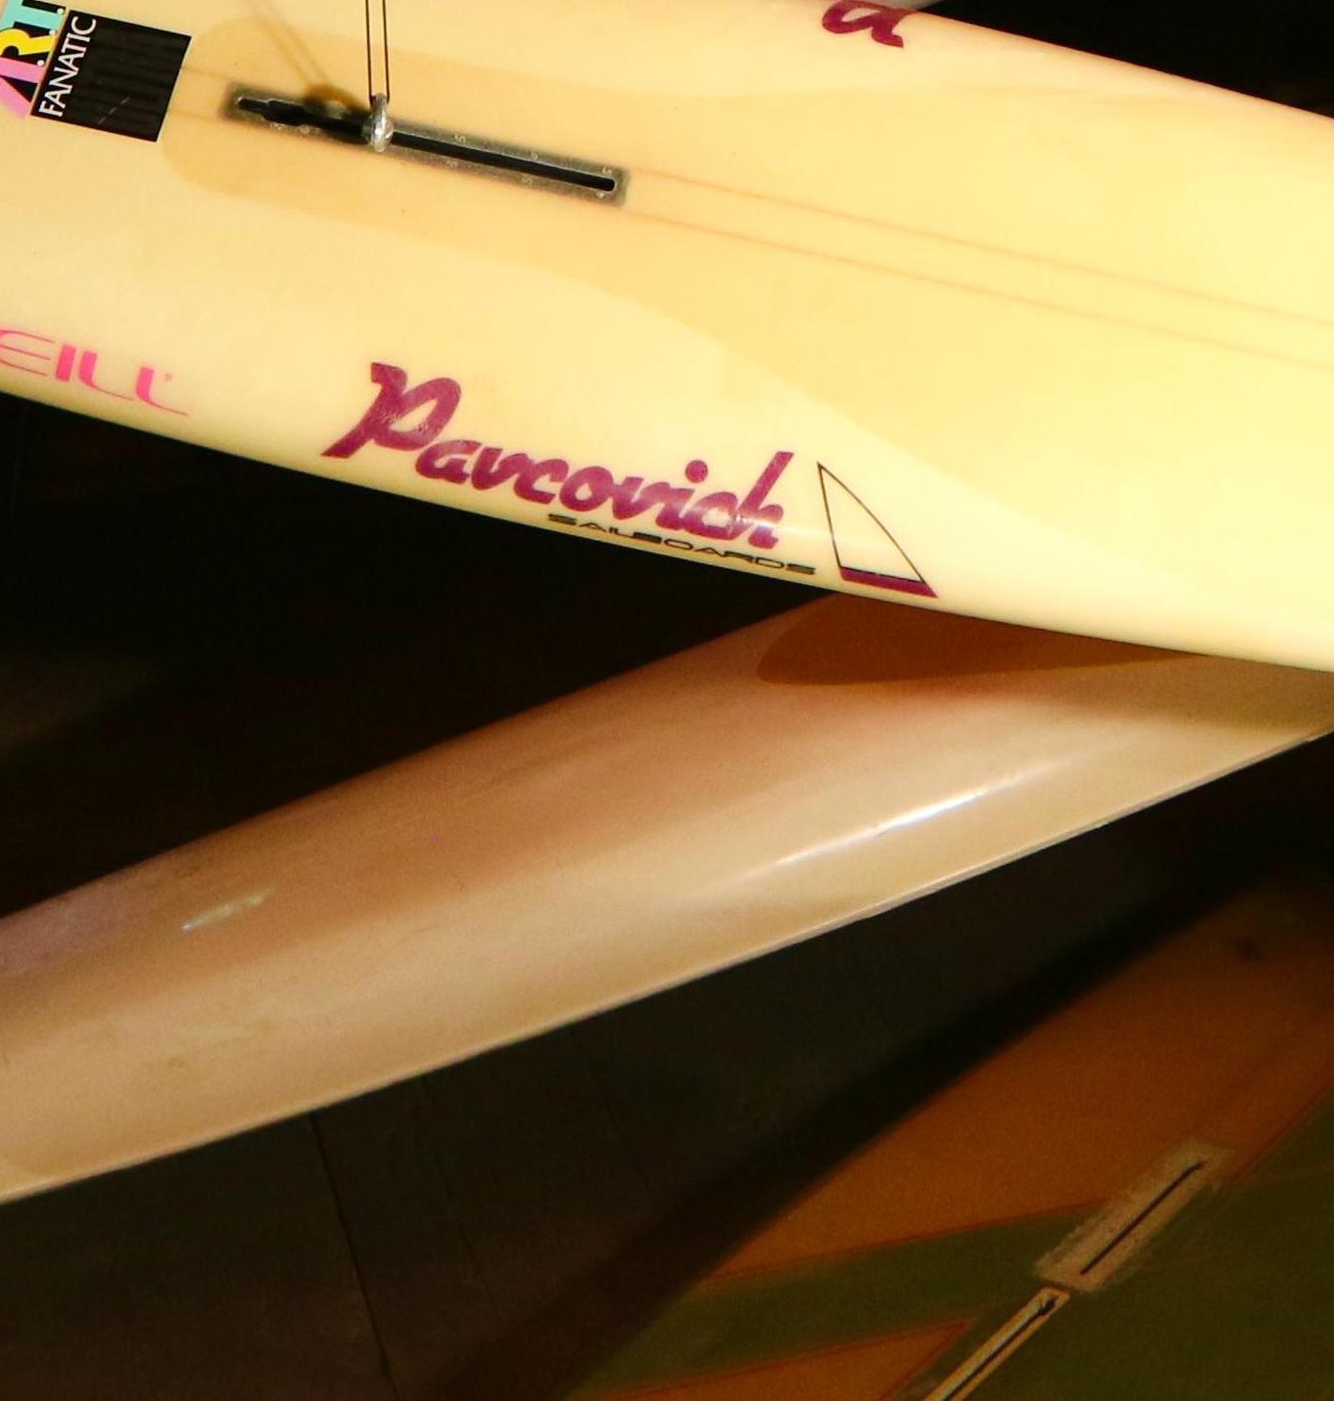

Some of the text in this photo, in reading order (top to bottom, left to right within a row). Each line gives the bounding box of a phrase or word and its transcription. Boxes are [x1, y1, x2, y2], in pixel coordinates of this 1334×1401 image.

[39, 15, 97, 118] FANATIC
[321, 362, 794, 550] Pavcovich
[548, 512, 817, 576] SAILBOARDS
